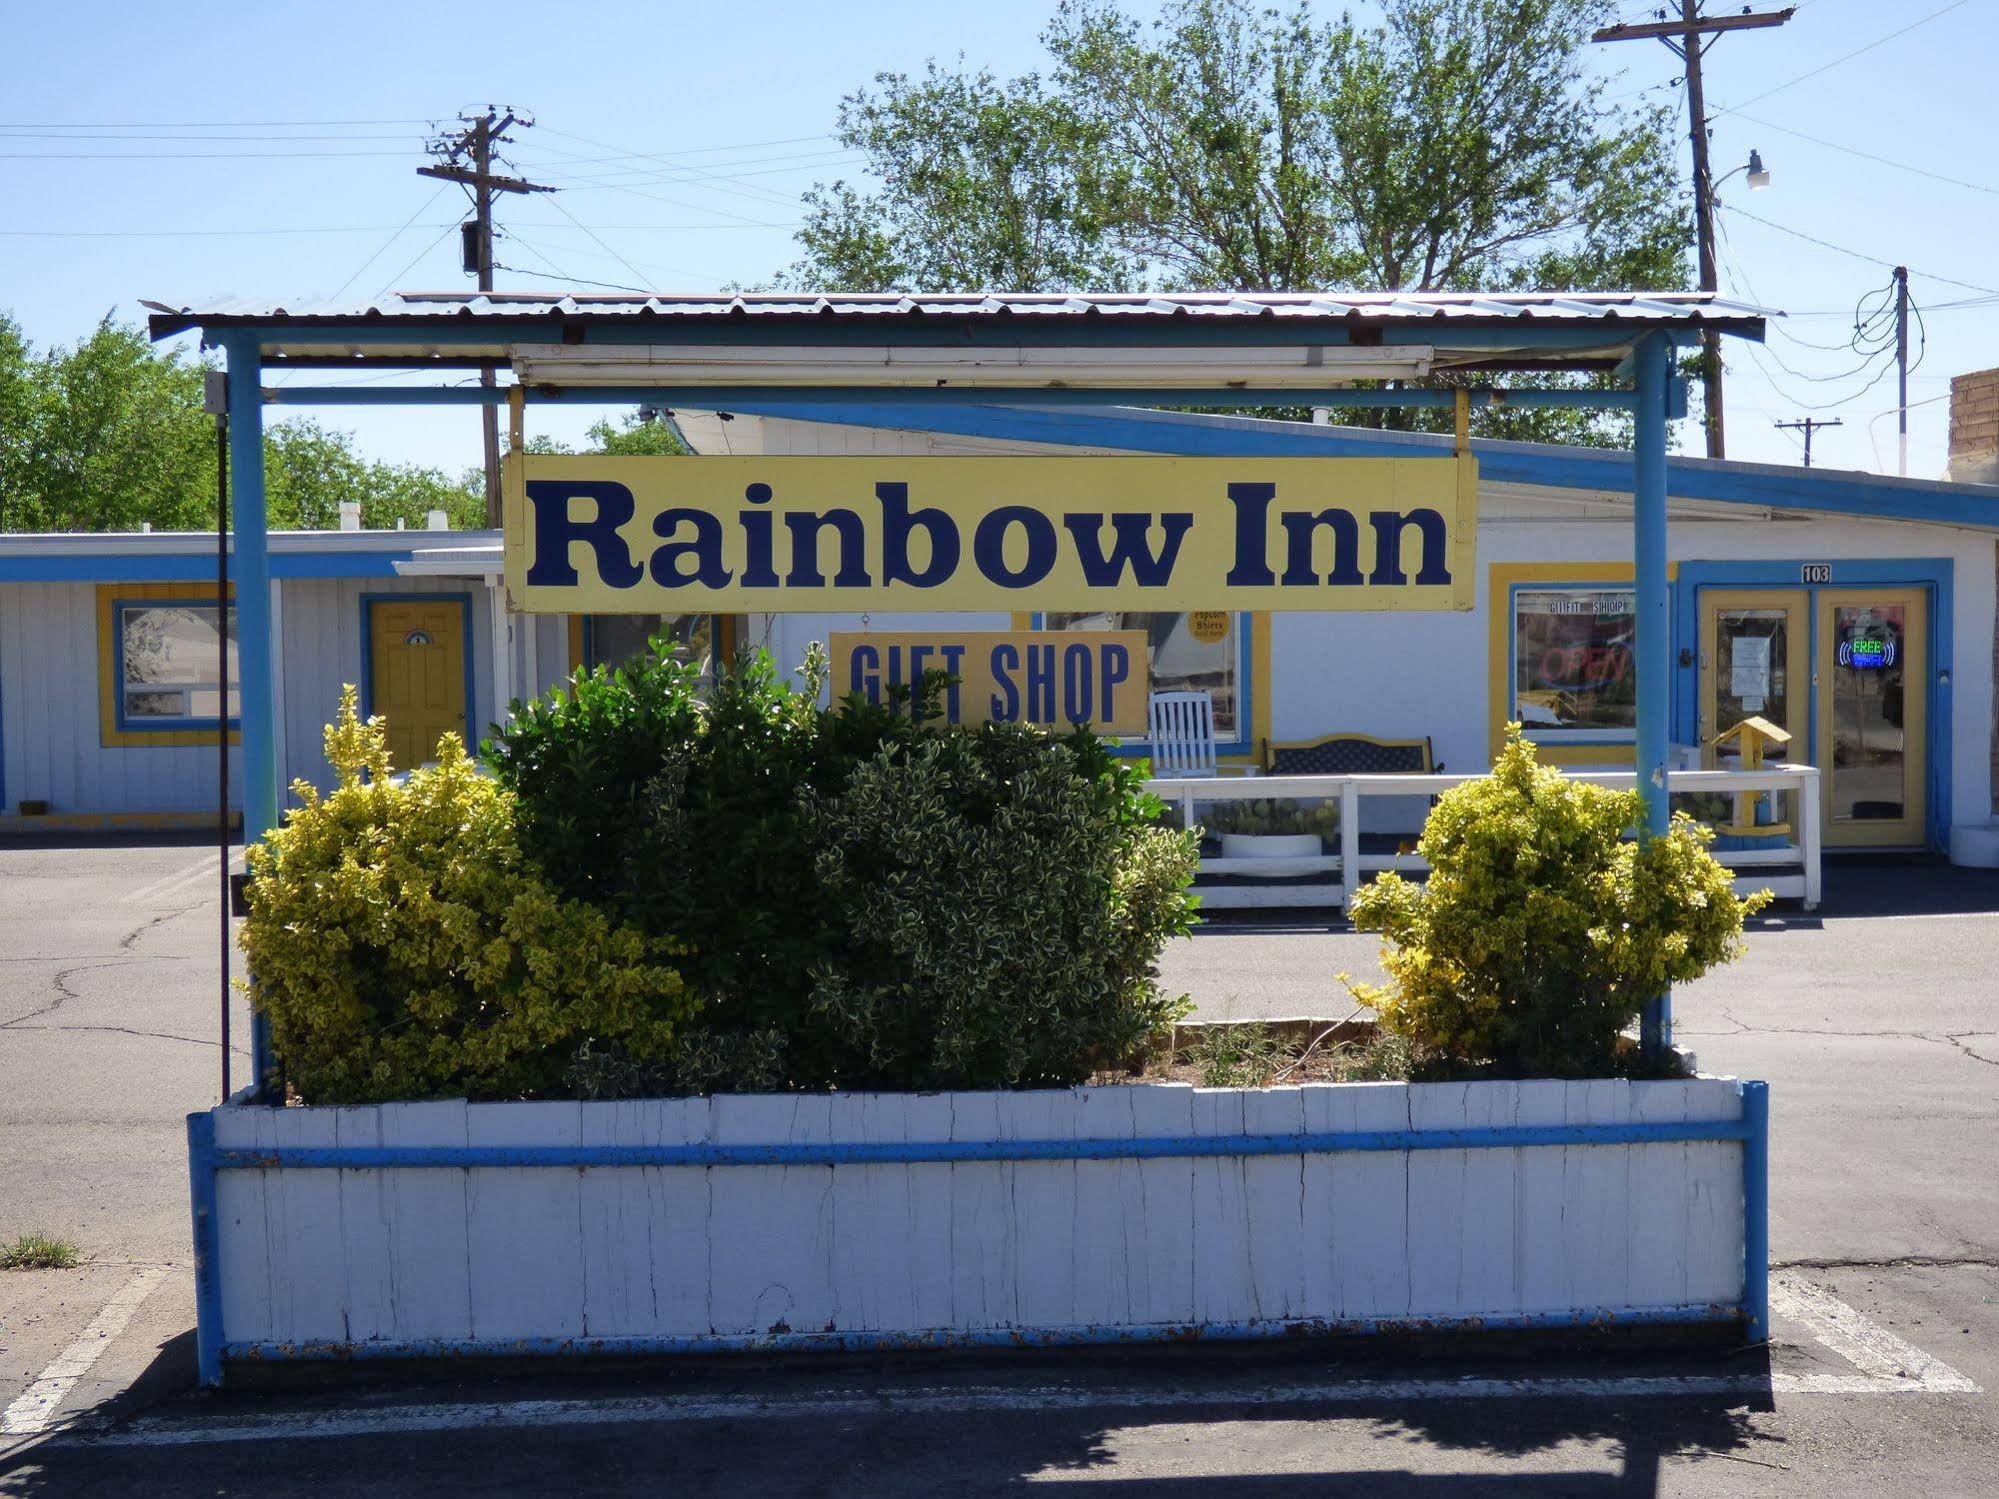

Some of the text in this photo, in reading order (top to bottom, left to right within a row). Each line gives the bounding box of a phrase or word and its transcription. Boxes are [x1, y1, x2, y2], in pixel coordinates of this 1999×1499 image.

[526, 480, 1452, 590] Rainbow Inn
[1804, 566, 1829, 582] 103
[1549, 600, 1624, 614] GIFT SHOP
[1196, 621, 1224, 630] Shirts
[1853, 640, 1881, 653] FREE
[1541, 647, 1628, 683] OPEN
[990, 643, 1129, 724] SHOP
